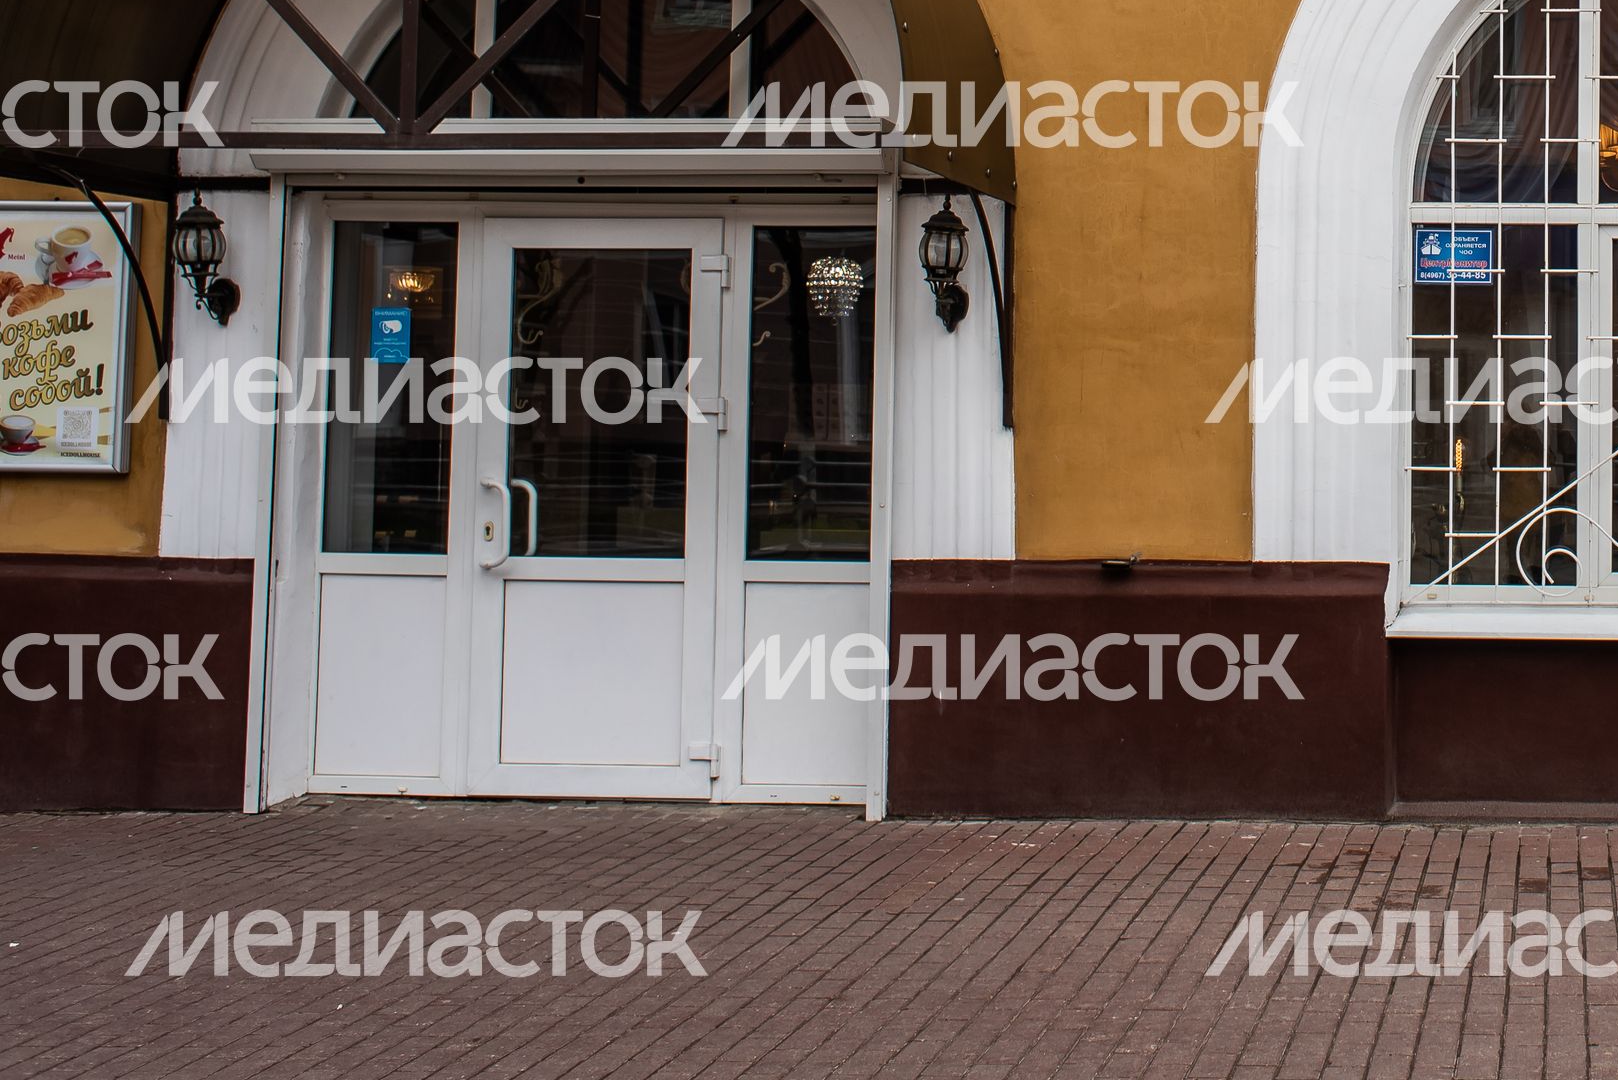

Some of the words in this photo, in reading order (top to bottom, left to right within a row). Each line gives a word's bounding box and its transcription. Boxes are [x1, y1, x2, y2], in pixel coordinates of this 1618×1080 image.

[0, 309, 93, 357] озьми
[2, 340, 76, 386] кофе
[9, 363, 105, 411] собой!
